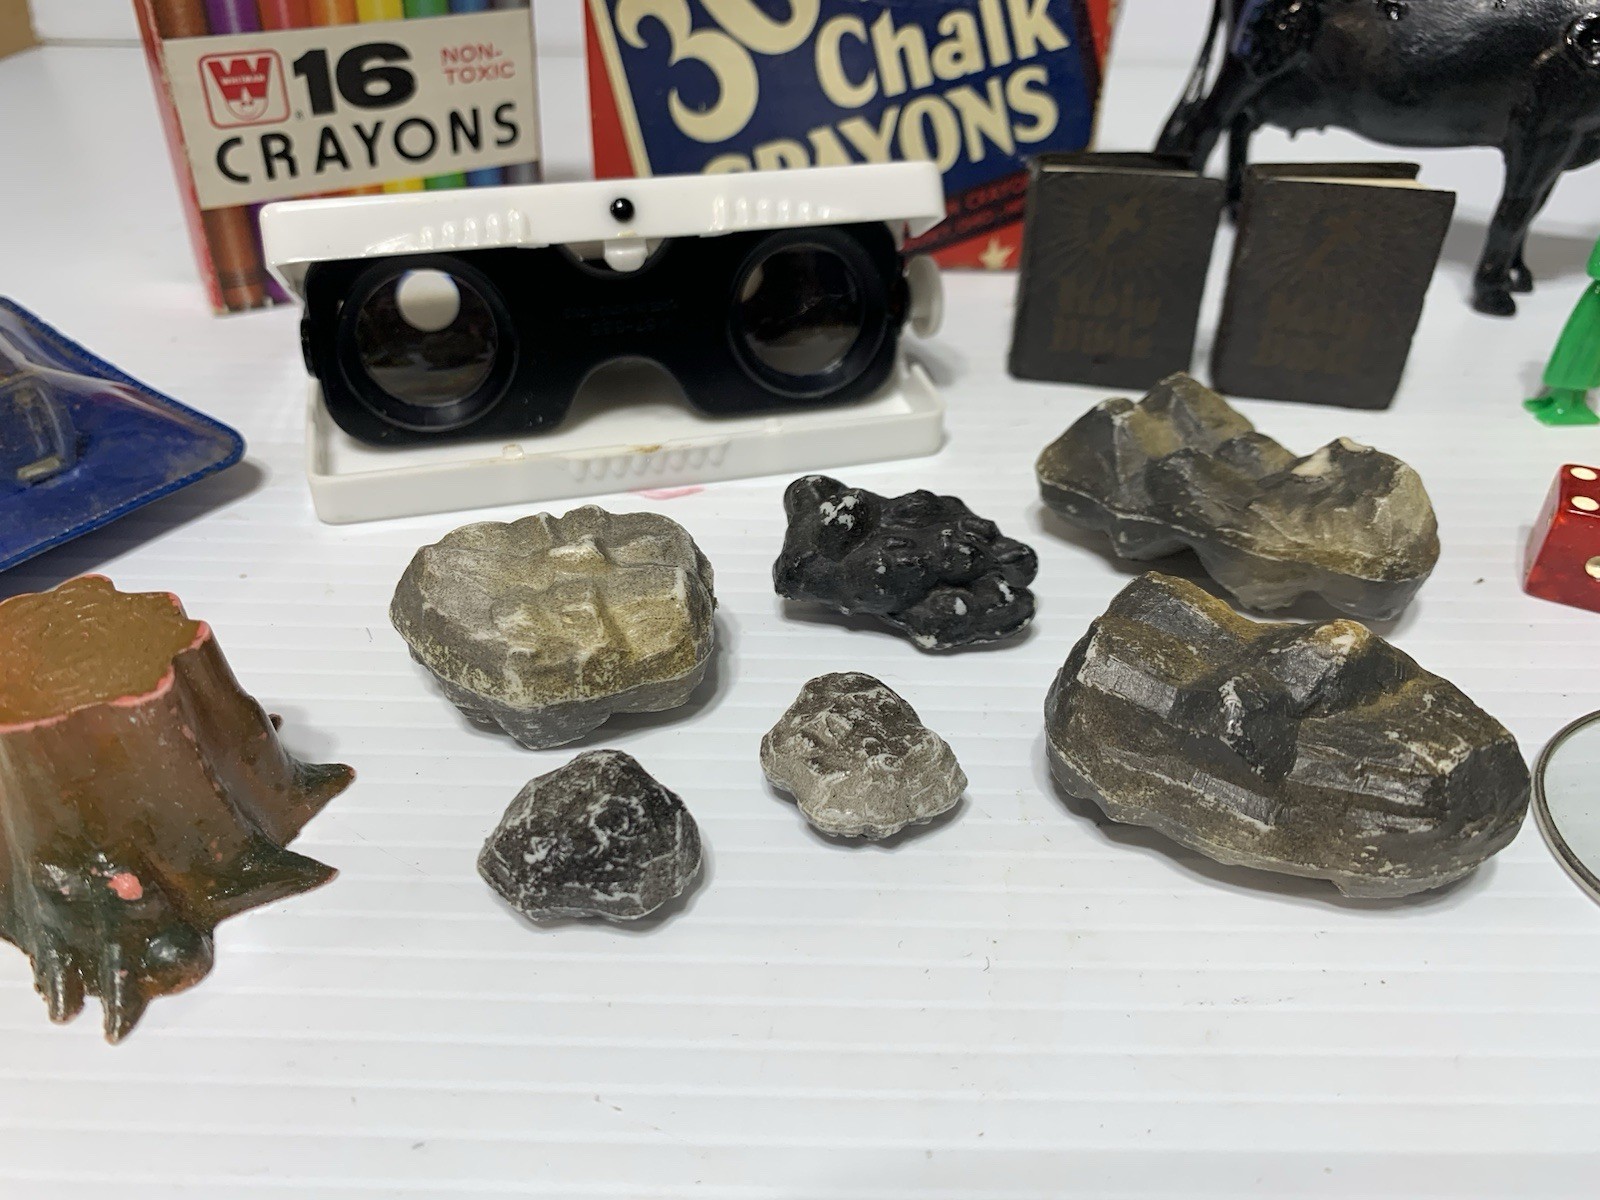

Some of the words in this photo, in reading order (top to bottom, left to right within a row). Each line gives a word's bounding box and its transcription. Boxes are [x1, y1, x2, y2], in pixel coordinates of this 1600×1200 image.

[293, 43, 416, 116] 16
[440, 42, 503, 66] NON-
[443, 60, 515, 85] TOXIC
[815, 0, 1068, 108] Chalk
[216, 103, 519, 183] CRAYONS
